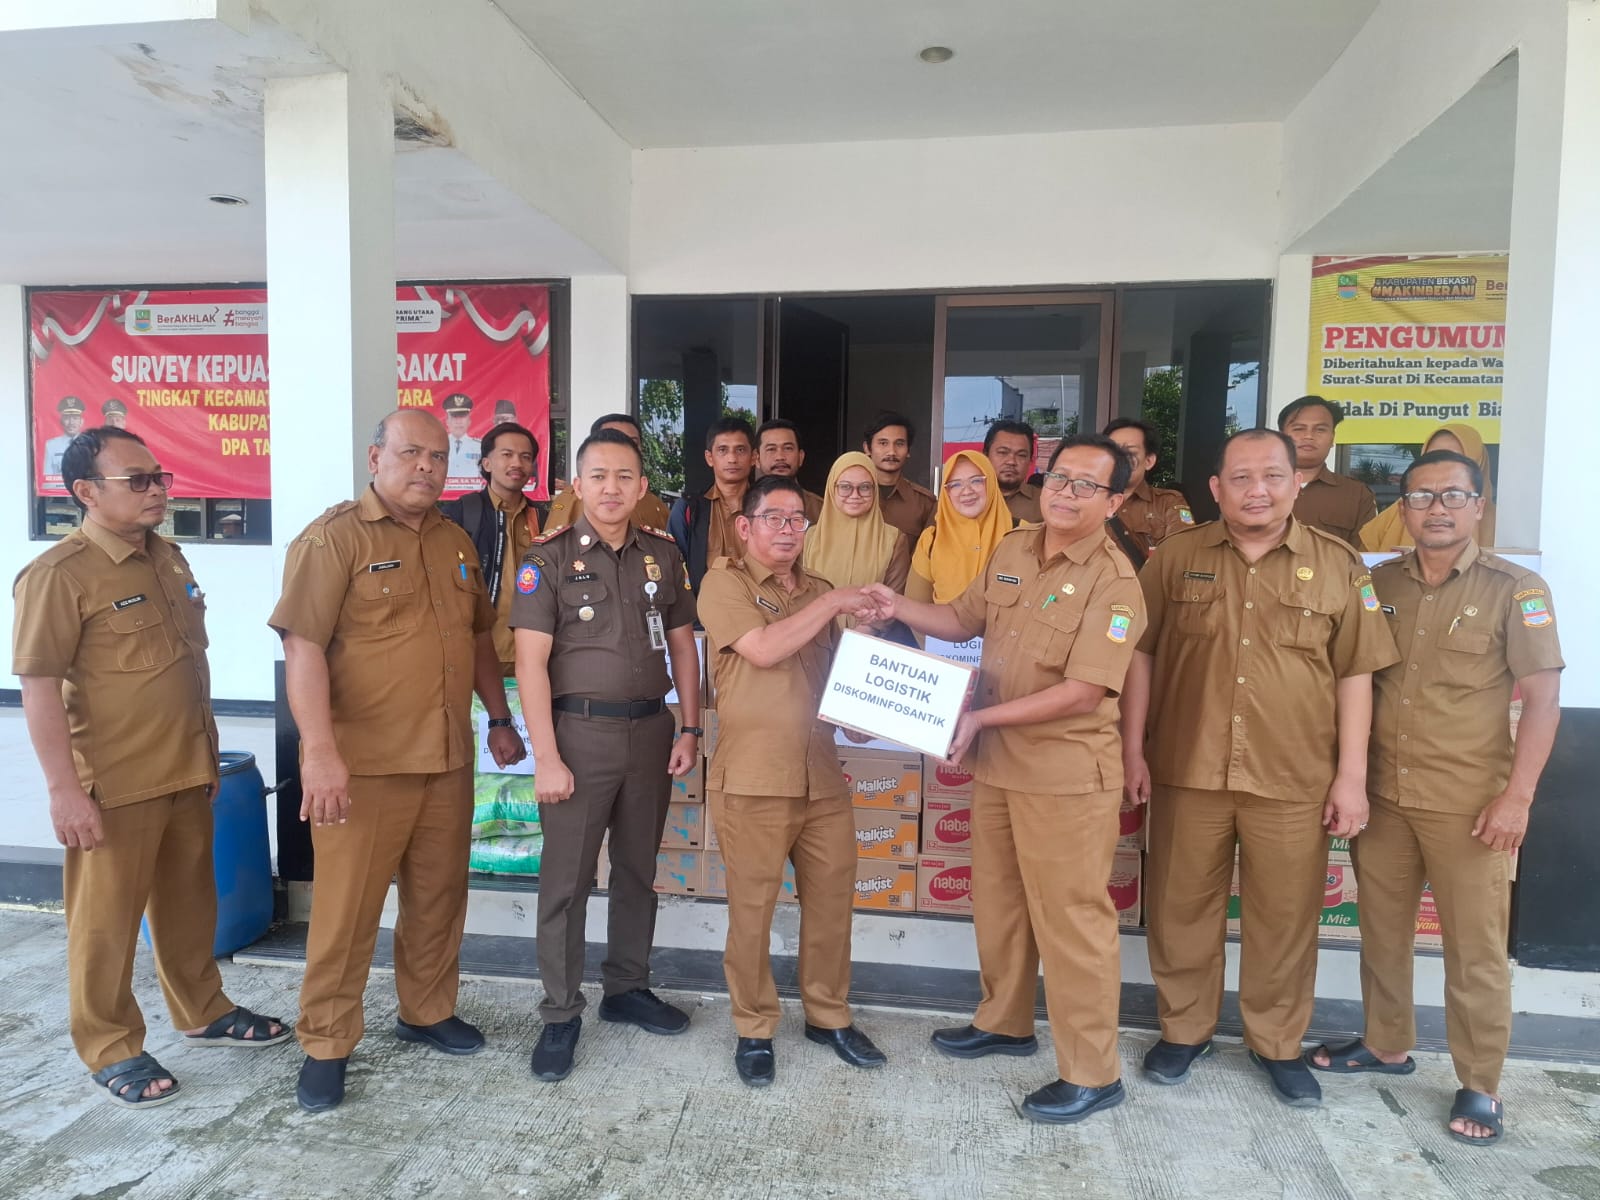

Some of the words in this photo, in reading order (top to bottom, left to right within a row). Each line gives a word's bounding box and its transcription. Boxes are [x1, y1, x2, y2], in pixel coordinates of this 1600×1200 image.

[1436, 276, 1469, 285] BEKASI
[1371, 285, 1475, 297] #MAKINBERANI
[157, 313, 216, 324] BerAKHLAK
[111, 355, 192, 382] SURVEY
[197, 354, 269, 383] KEPUA
[1323, 358, 1422, 369] Diberitahukan
[1426, 357, 1478, 371] kepada
[1481, 358, 1504, 368] Wa
[1322, 374, 1402, 385] Surat-Surat
[1405, 374, 1420, 384] Di
[1424, 374, 1504, 384] Kecamatan
[137, 389, 200, 407] TINGKAT
[204, 388, 269, 407] KECAMA
[1379, 402, 1398, 416] Di
[1403, 401, 1469, 419] Pungut
[208, 413, 270, 431] KABUPA
[221, 438, 250, 456] DPA
[253, 438, 271, 456] TA
[870, 654, 939, 686] BANTUAN
[865, 672, 932, 704] LOGISTIK
[833, 682, 946, 728] DISKOMINFOSANTIK
[857, 776, 898, 793] Malkist
[855, 826, 895, 842] Malkist
[1332, 838, 1350, 850] Mi
[1326, 914, 1351, 925] Mie
